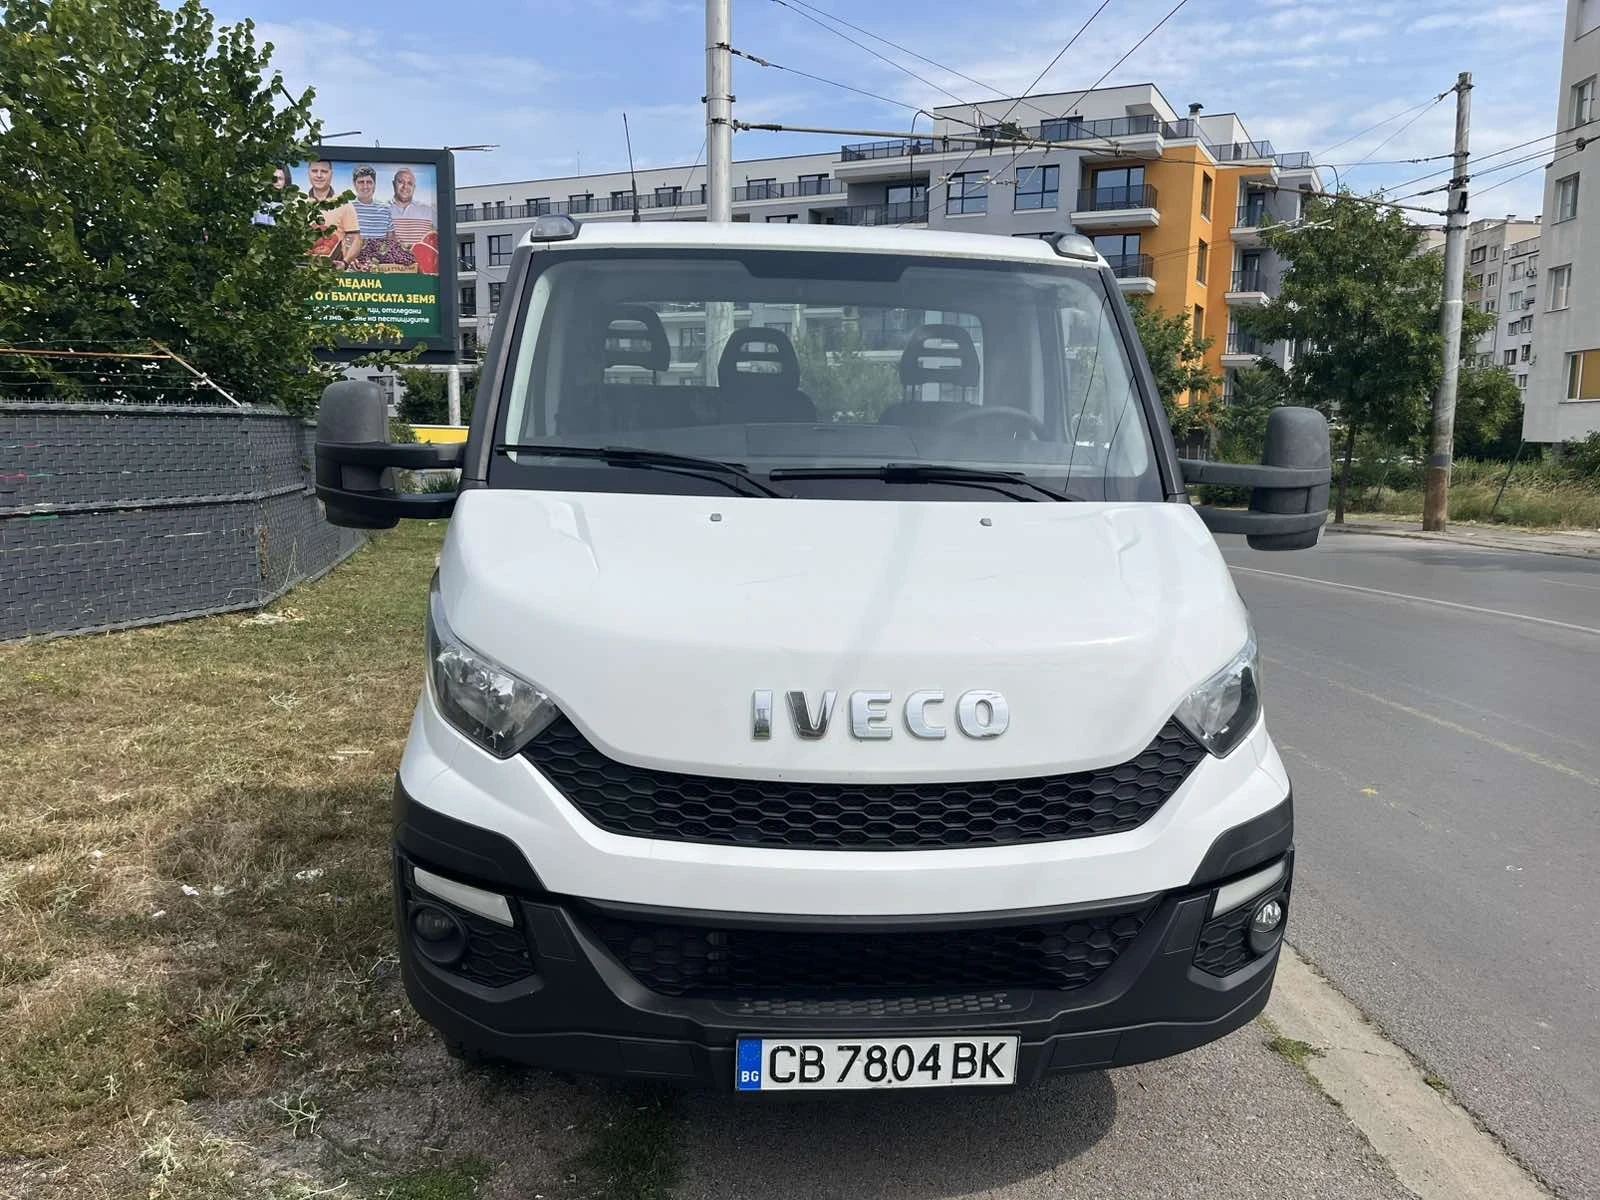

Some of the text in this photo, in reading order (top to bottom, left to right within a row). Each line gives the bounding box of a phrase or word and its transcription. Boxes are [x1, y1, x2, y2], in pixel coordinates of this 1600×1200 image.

[336, 278, 382, 289] ЛЕДАНА
[331, 291, 404, 303] БЪЛГАРСКАТА
[406, 293, 436, 304] ЗЕМЯ
[752, 689, 1010, 740] IVECO
[741, 1071, 759, 1083] BG
[837, 1043, 941, 1084] 7804
